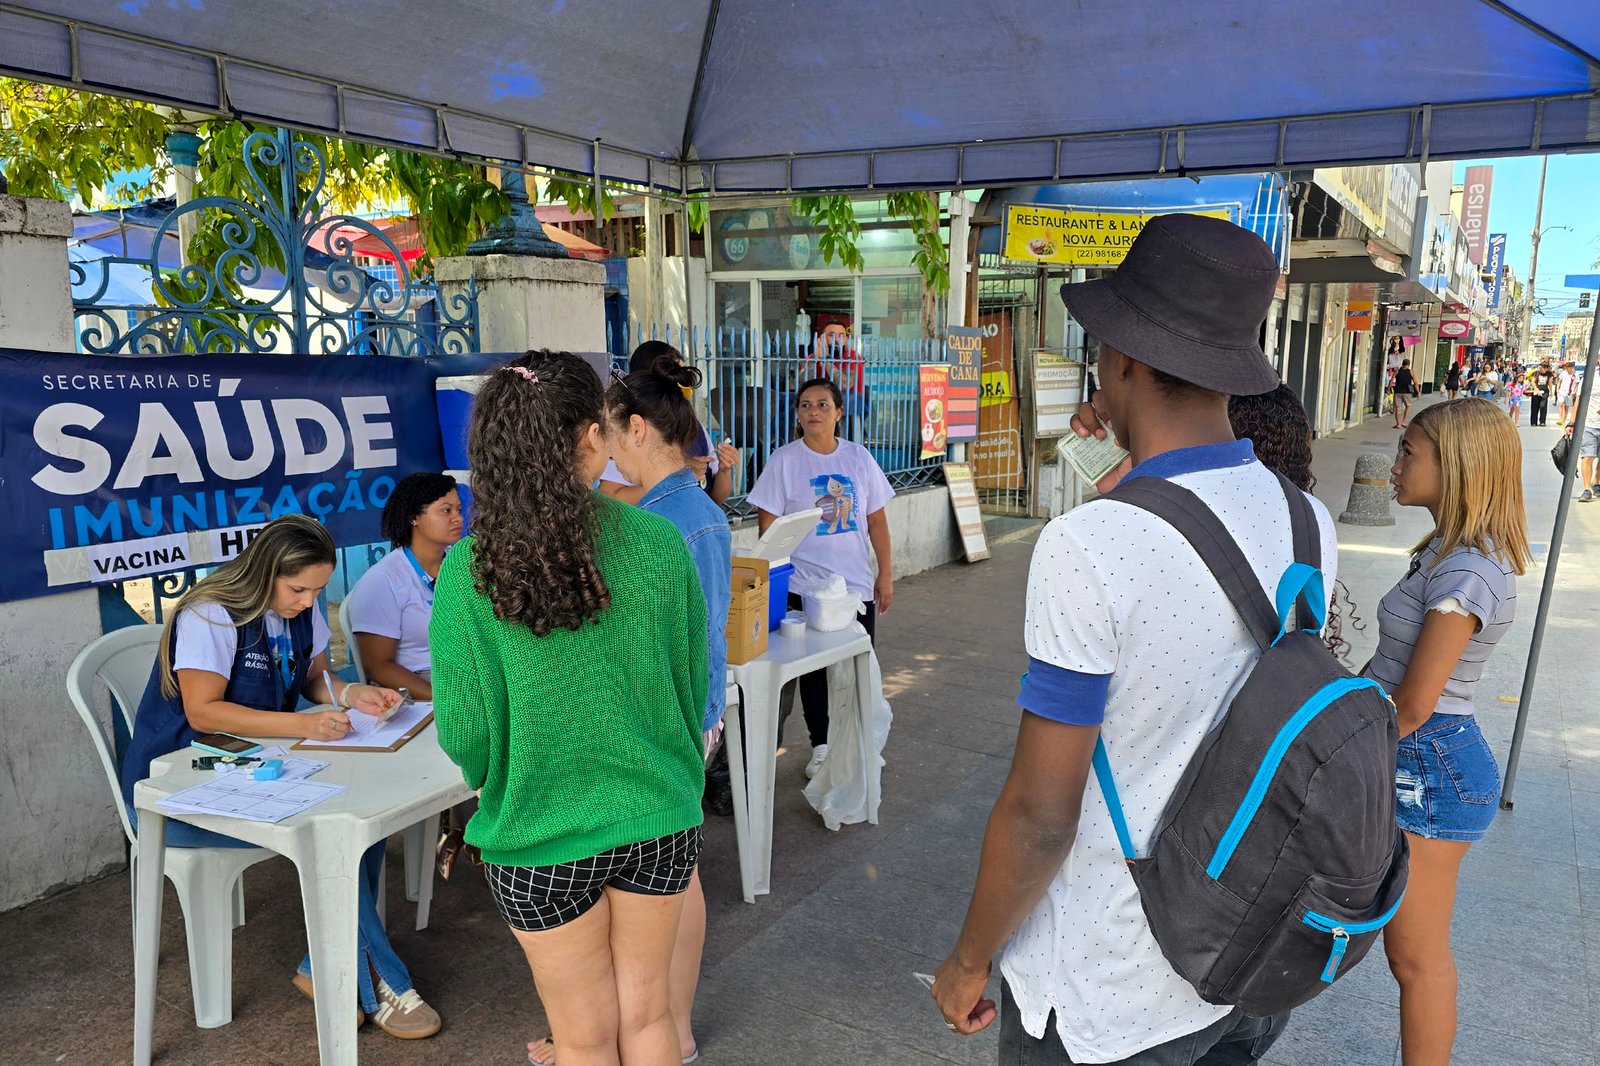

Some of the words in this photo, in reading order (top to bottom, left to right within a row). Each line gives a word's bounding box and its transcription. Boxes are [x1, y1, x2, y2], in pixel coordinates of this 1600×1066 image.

[1016, 214, 1104, 230] RESTAURANTE
[1108, 220, 1117, 230] &
[1465, 184, 1485, 247] marisa
[731, 239, 744, 254] 66
[1063, 234, 1097, 245] NOVA
[1077, 250, 1093, 259] (22)
[948, 334, 982, 351] CALDO
[959, 351, 972, 365] DE
[950, 366, 979, 381] CANA
[43, 374, 179, 390] SECRETARIA
[187, 374, 212, 388] DE
[31, 378, 397, 495] SAÚDE
[49, 469, 396, 550] IMUNIZAÇÃO
[94, 546, 186, 575] VACINA
